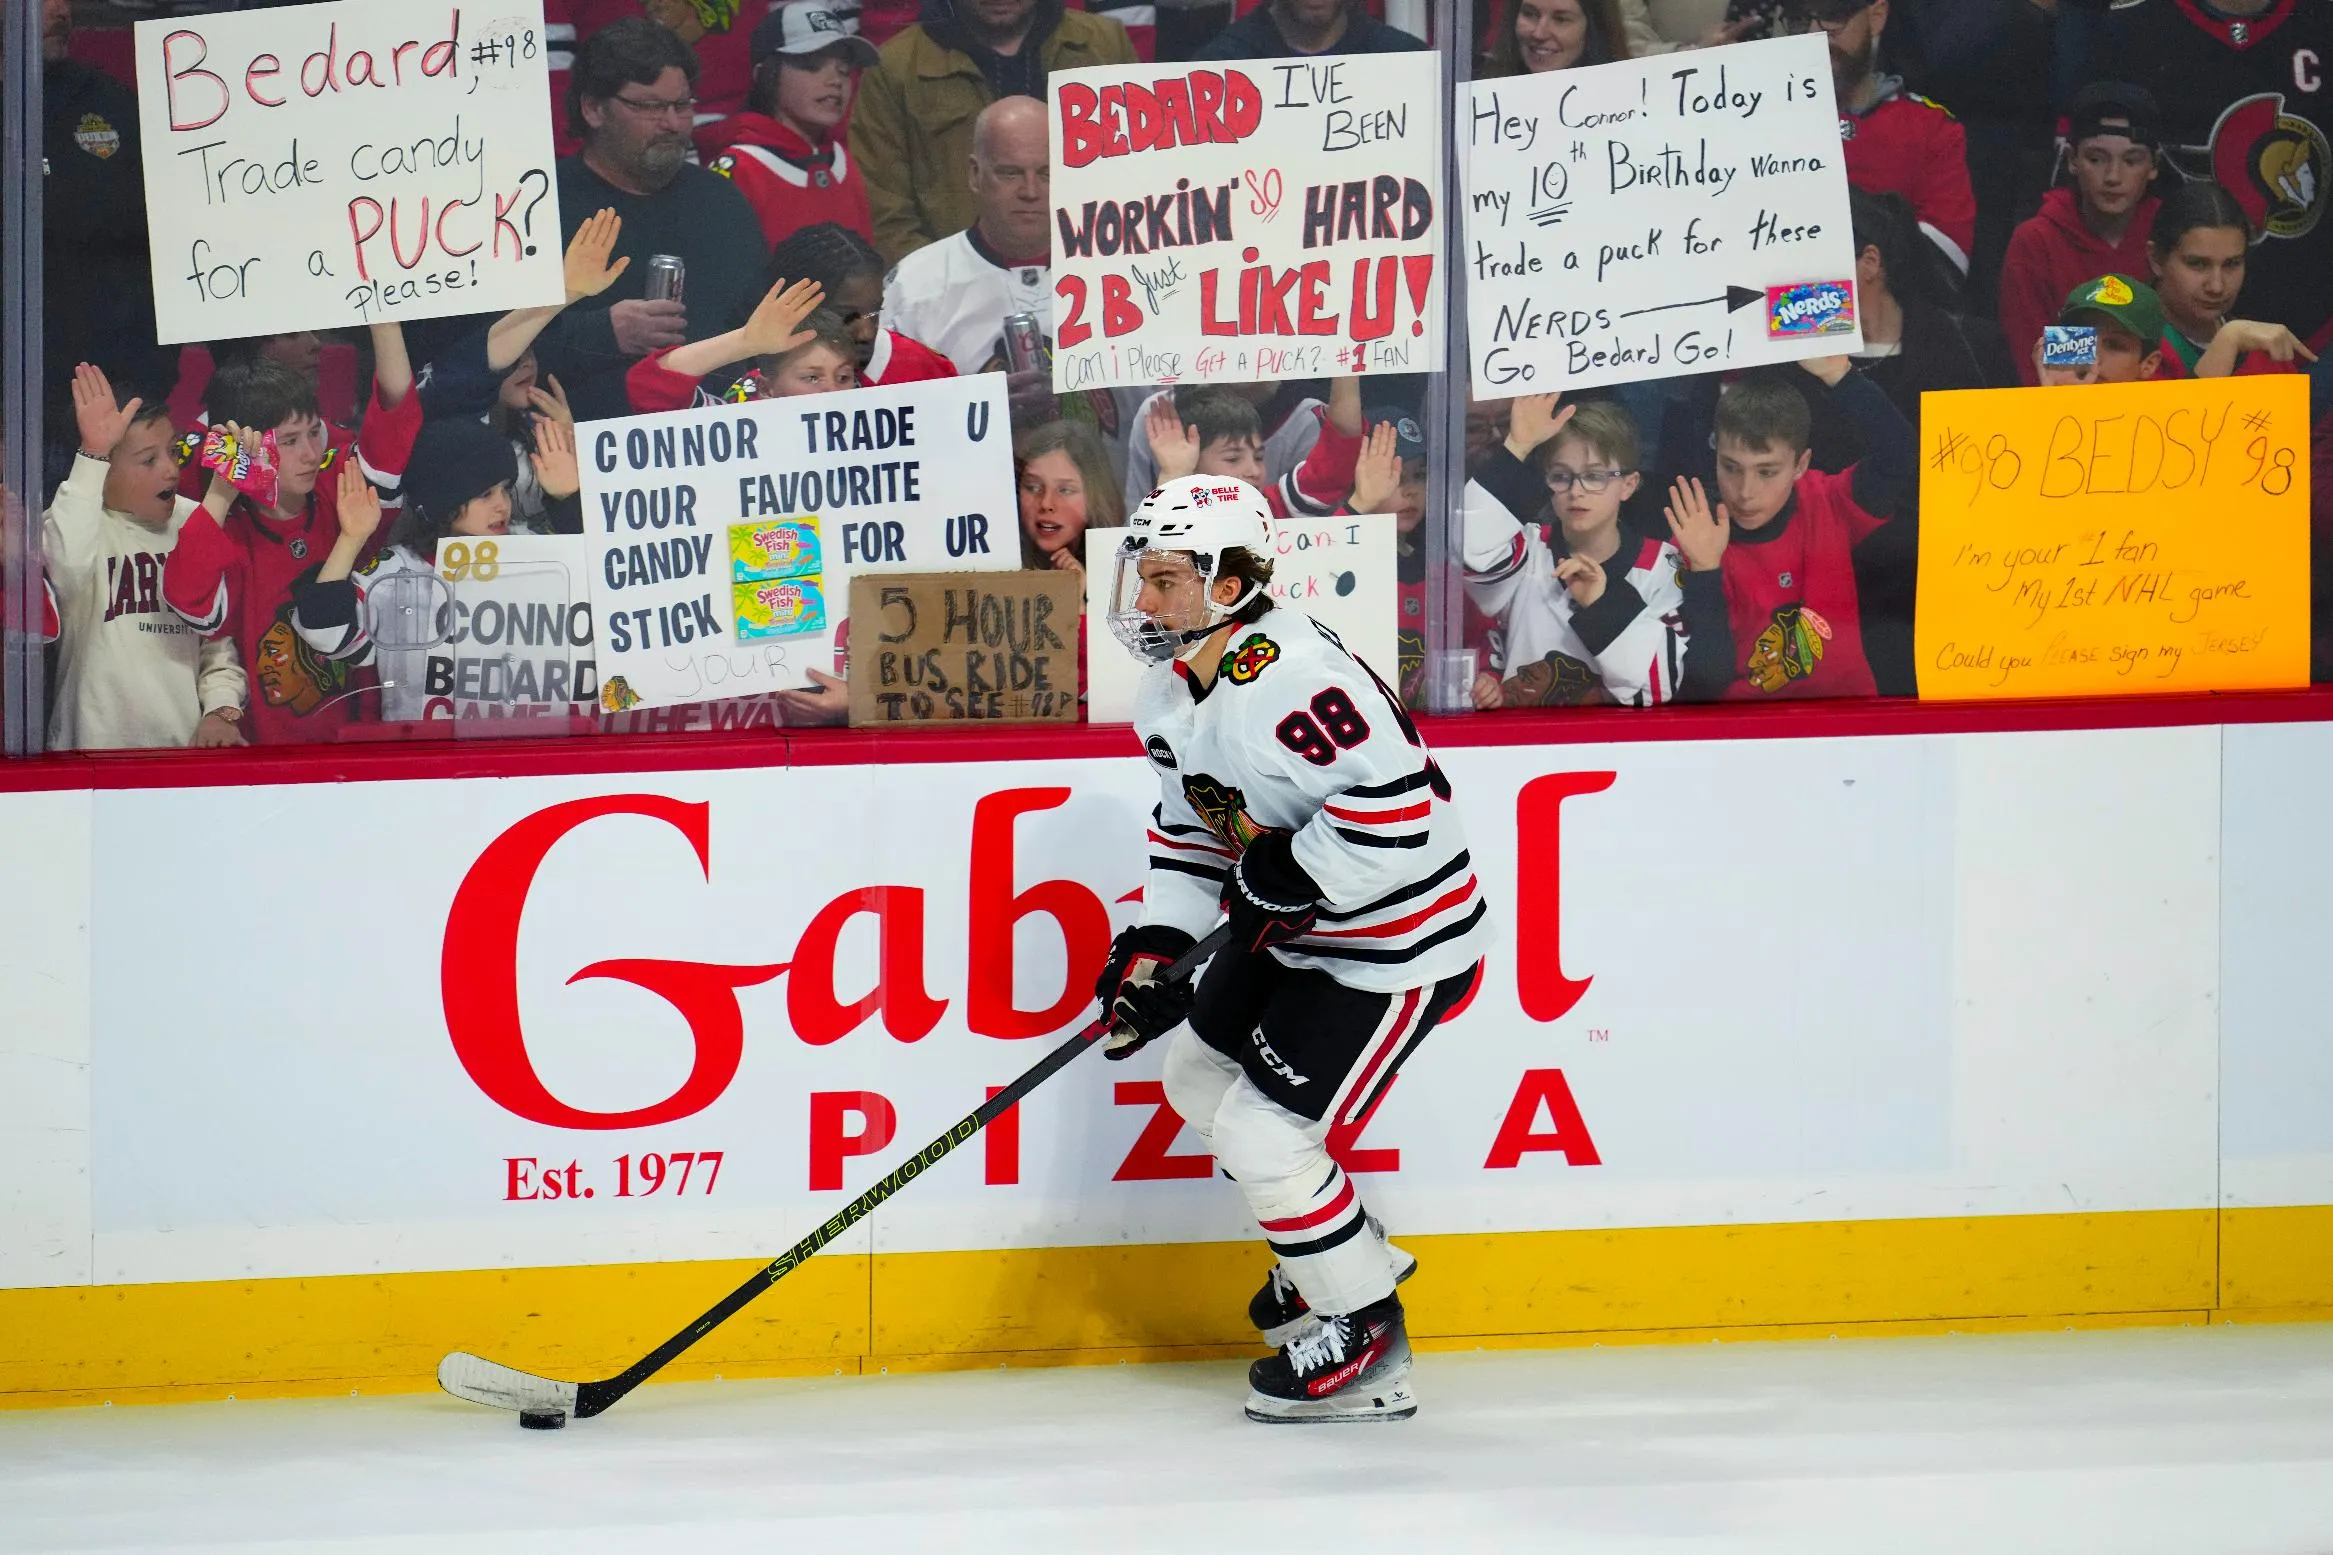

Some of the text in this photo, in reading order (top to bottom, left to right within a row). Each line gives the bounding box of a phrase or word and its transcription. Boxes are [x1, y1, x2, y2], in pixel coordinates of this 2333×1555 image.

[470, 29, 537, 68] #98
[2293, 49, 2322, 93] C
[1058, 62, 1352, 167] BEDARD I'VE
[1322, 103, 1406, 151] BEEN
[1472, 91, 1538, 150] Hey
[1671, 64, 1762, 118] Today
[1787, 74, 1816, 101] is
[177, 115, 484, 206] Trade candy
[1244, 168, 1283, 216] SO
[1303, 174, 1434, 249] HARD
[1472, 190, 1511, 226] my
[187, 168, 550, 302] for a PUCK?
[1472, 241, 1543, 281] trade
[1563, 251, 1580, 269] a
[1683, 217, 1723, 255] for
[1748, 209, 1822, 250] these
[1493, 298, 1611, 342] NERDS
[1335, 342, 1368, 373] #1
[1373, 337, 1410, 368] FAN
[1484, 328, 1732, 385] Go Bedard Go!
[2046, 335, 2094, 357] Dentyne
[594, 401, 990, 474] CONNOR TRADE U
[1931, 427, 2021, 508] #98
[2040, 401, 2234, 498] BEDSY
[600, 460, 921, 534] YOUR FAVOURITE
[1211, 486, 1240, 495] BELLE
[1217, 494, 1239, 502] TIRE
[752, 527, 799, 548] Swedish
[764, 540, 791, 553] Fish
[1132, 518, 1152, 527] CCM
[1345, 524, 1360, 545] I
[442, 540, 500, 582] 98
[603, 512, 991, 592] CANDY FOR UR
[1953, 543, 1992, 567] I'm
[1987, 543, 2069, 592] your
[2114, 530, 2158, 563] fan
[756, 584, 803, 605] Swedish
[769, 597, 794, 610] Fish
[1270, 575, 1320, 599] uck
[2013, 570, 2252, 630] My 1st NHL game
[138, 621, 196, 635] UNIVERSIT
[435, 599, 594, 647] CONNO
[610, 593, 723, 653] STICK
[878, 586, 1066, 652] 5 HOUR
[424, 655, 599, 702] BEDARD
[664, 645, 793, 699] YOUR
[879, 648, 1053, 694] BUS RIDE
[1936, 641, 1994, 671] Could
[1988, 656, 2032, 687] you
[2155, 644, 2183, 679] my
[876, 689, 935, 721] TO
[945, 686, 1006, 719] SEE
[1275, 686, 1371, 767] 98
[441, 771, 1617, 1131] Gabl
[1251, 1023, 1310, 1087] CCM
[1586, 1029, 1608, 1042] TM
[502, 1151, 725, 1201] Est. 1977
[767, 1112, 980, 1284] SHERWOOD
